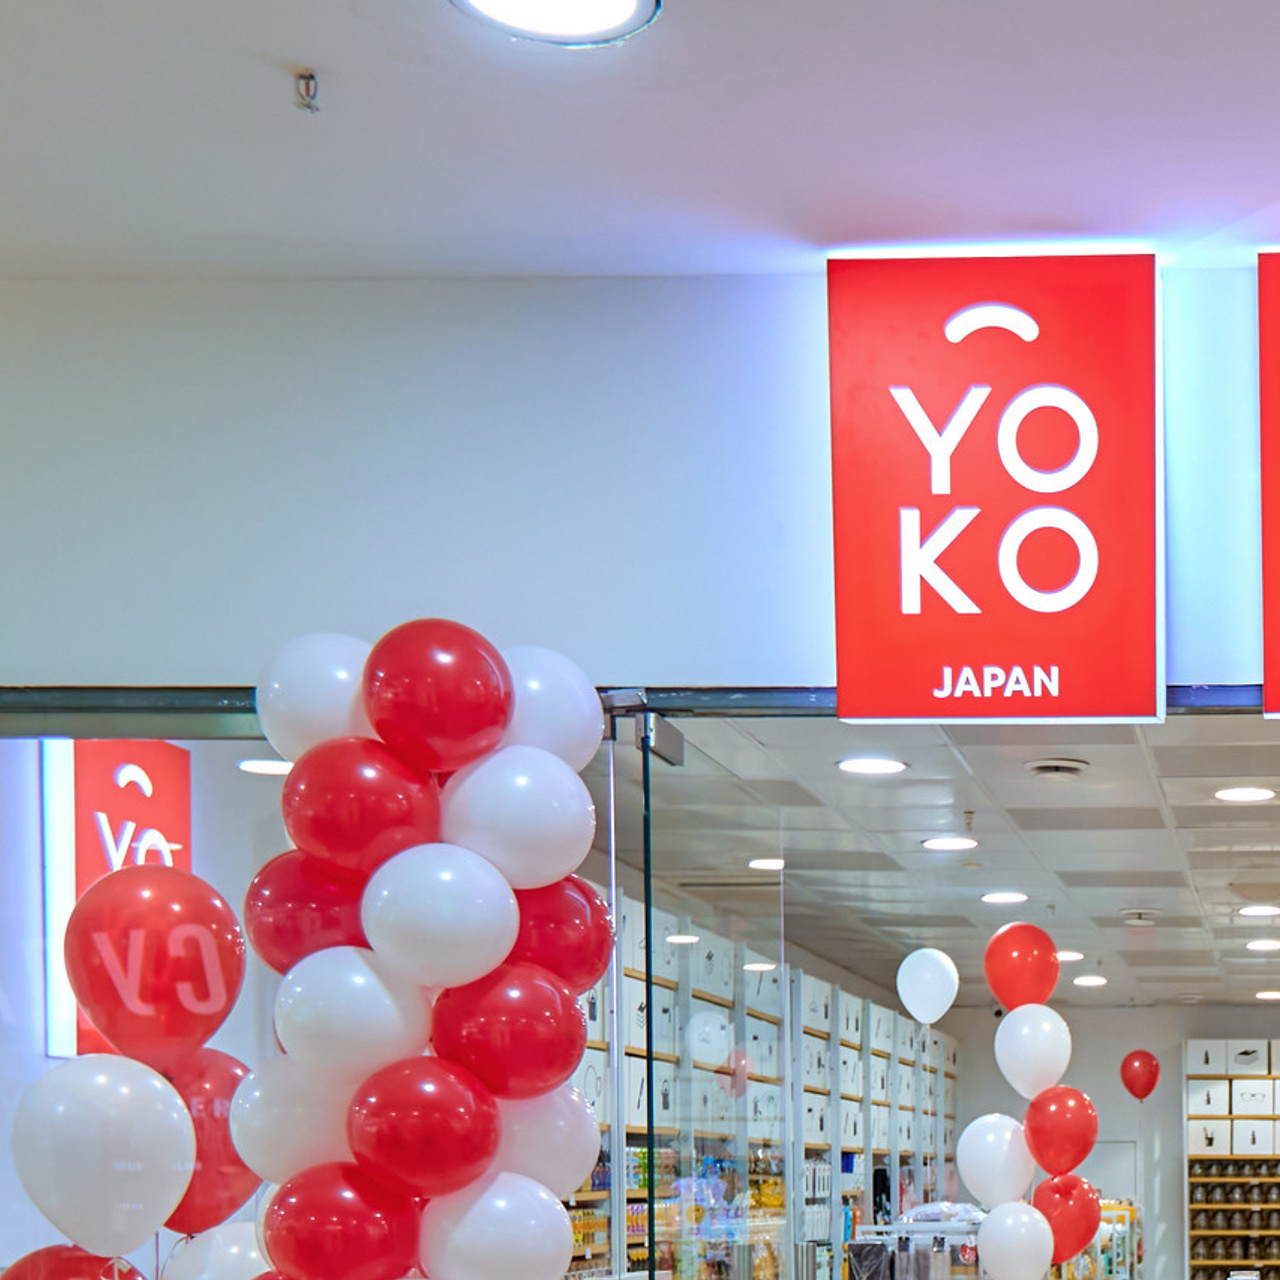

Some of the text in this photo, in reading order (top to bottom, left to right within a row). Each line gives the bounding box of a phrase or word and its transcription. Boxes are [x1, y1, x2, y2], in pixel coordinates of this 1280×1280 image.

[888, 384, 1100, 495] YO
[898, 506, 1100, 615] KO
[932, 665, 1060, 699] JAPAN
